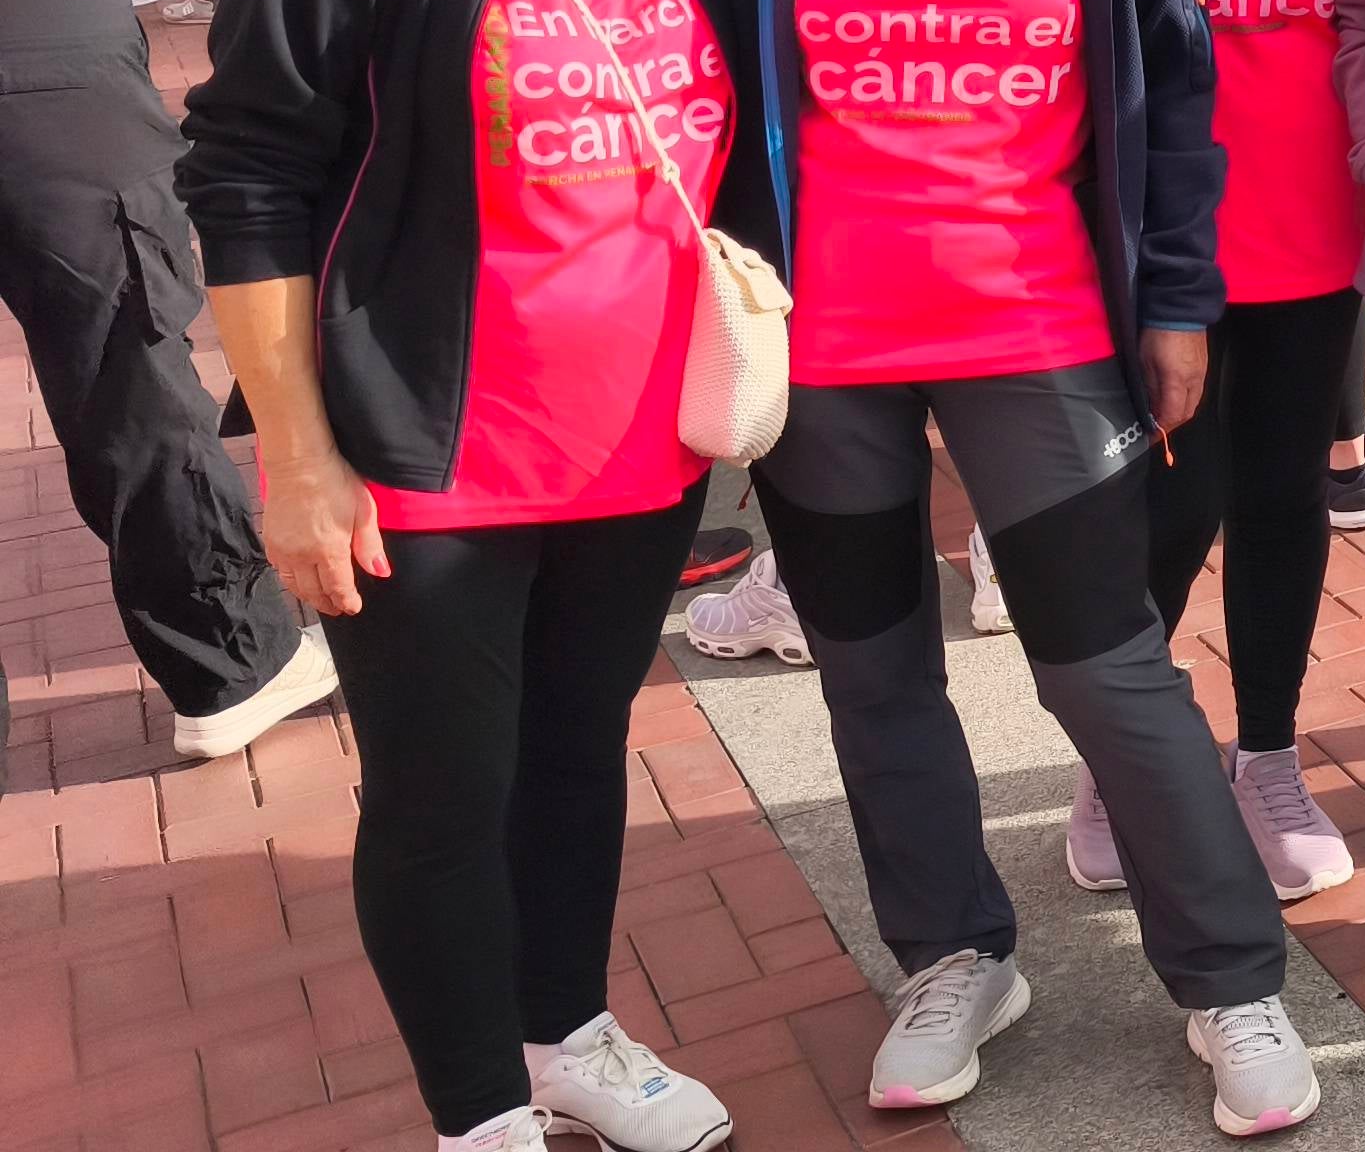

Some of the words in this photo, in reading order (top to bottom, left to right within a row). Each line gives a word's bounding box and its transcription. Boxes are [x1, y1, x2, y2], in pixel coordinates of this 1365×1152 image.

[507, 1, 578, 38] En
[799, 4, 1012, 47] contra
[1024, 4, 1076, 48] el
[809, 48, 1072, 107] cáncer
[517, 97, 725, 167] cánce
